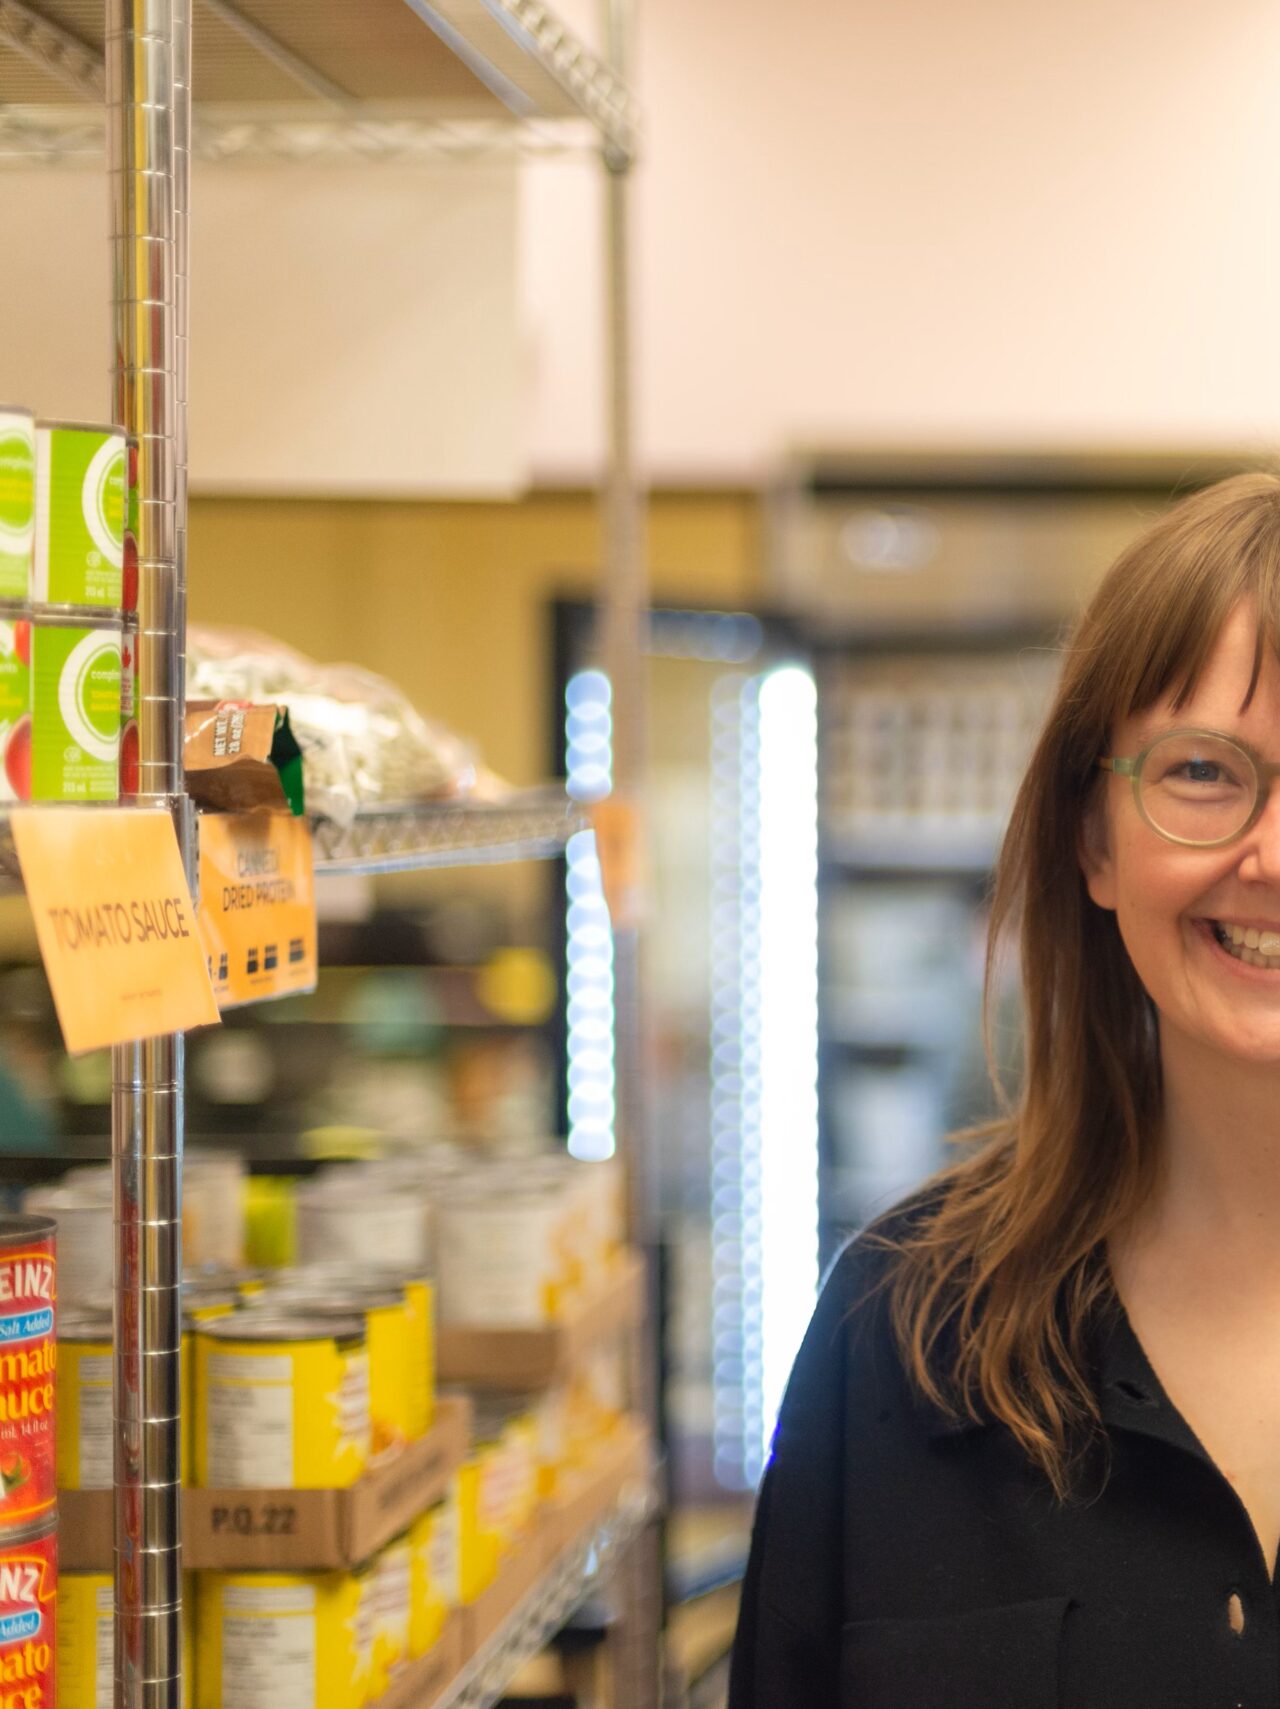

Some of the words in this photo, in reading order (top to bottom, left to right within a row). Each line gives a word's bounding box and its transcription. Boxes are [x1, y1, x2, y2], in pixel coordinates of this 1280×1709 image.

[222, 884, 254, 912] DRIED
[256, 878, 297, 906] PROTEIN
[48, 902, 133, 953] TOMATO
[131, 897, 190, 943] SAUCE
[23, 1313, 51, 1332] Added
